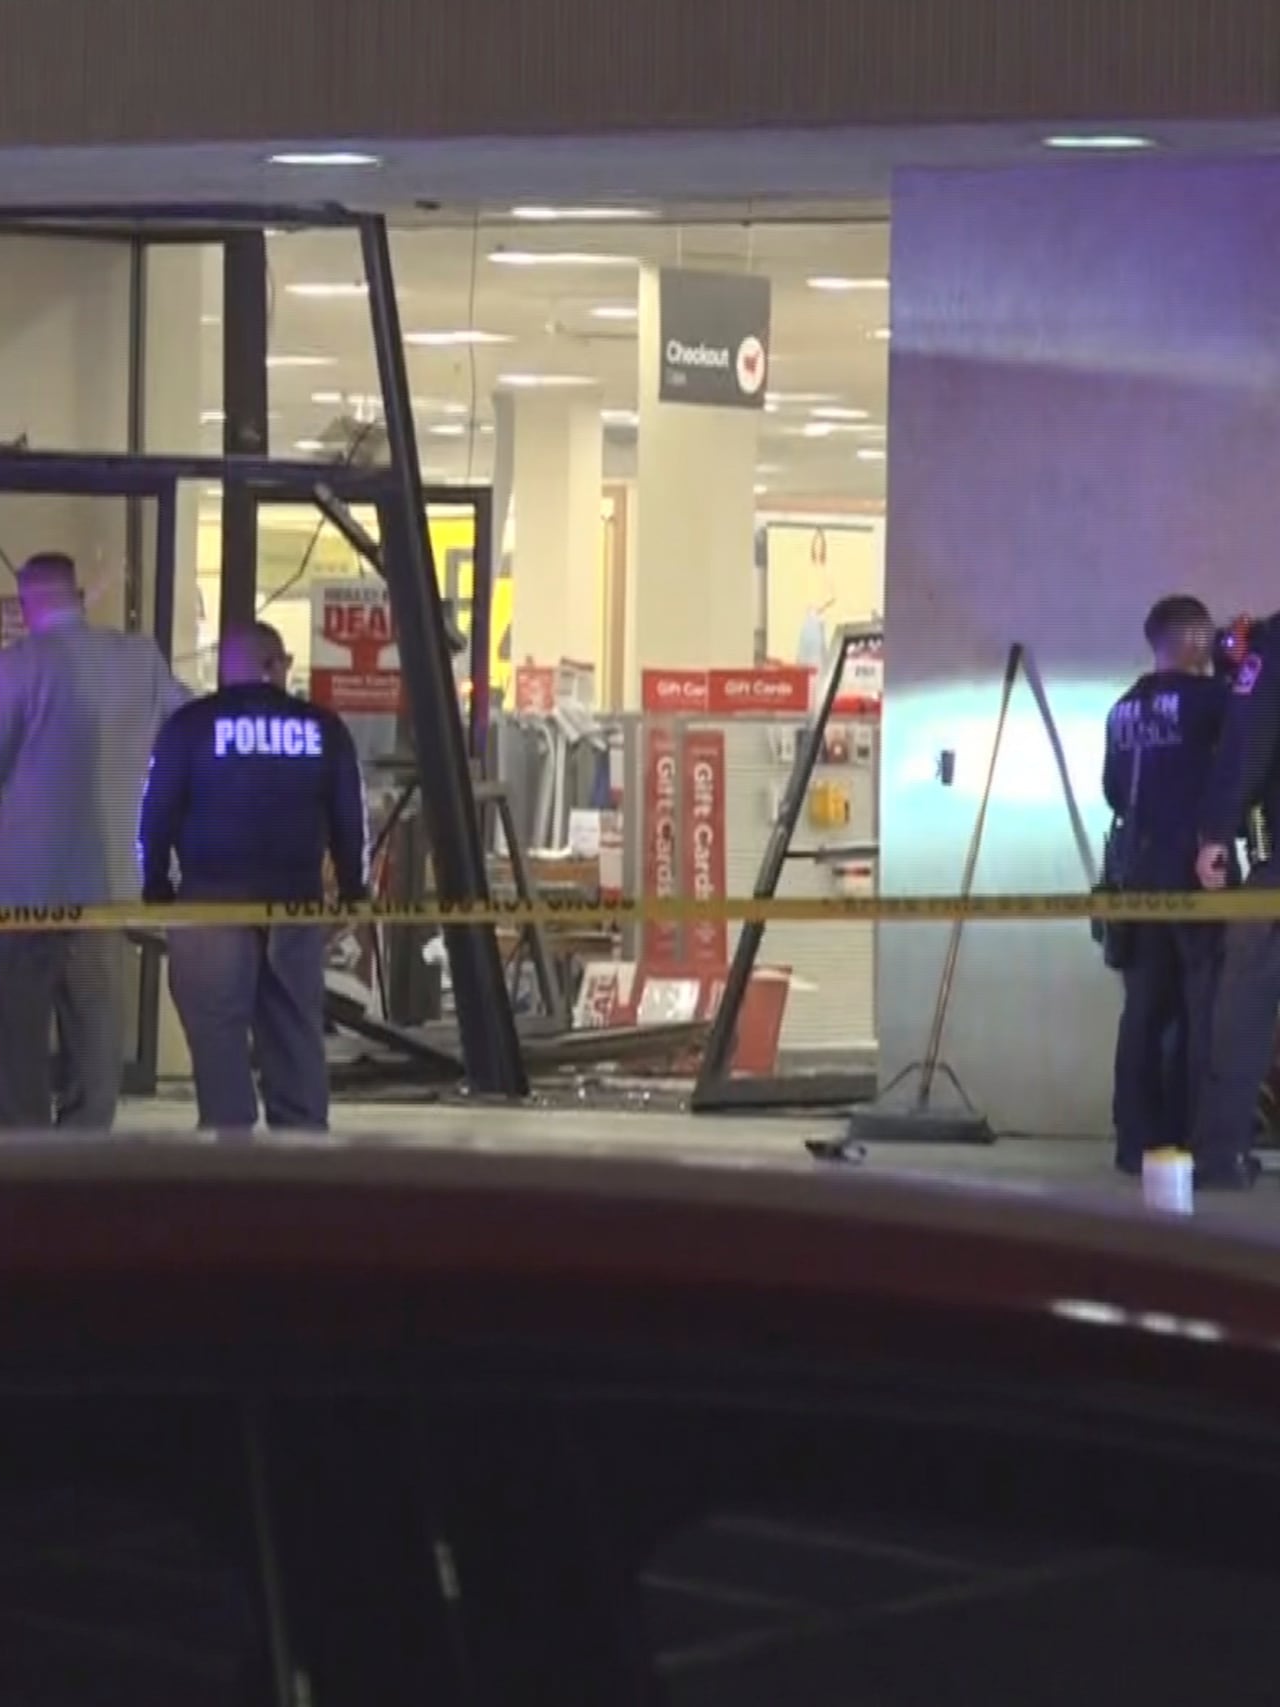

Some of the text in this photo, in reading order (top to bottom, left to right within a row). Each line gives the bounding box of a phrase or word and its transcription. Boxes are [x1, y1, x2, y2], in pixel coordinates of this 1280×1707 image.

[666, 339, 729, 367] Checkout
[657, 680, 681, 696] Gift
[724, 679, 793, 697] Gift Cards
[215, 716, 322, 756] POLICE
[657, 756, 675, 814] Gift
[693, 762, 713, 816] Gift
